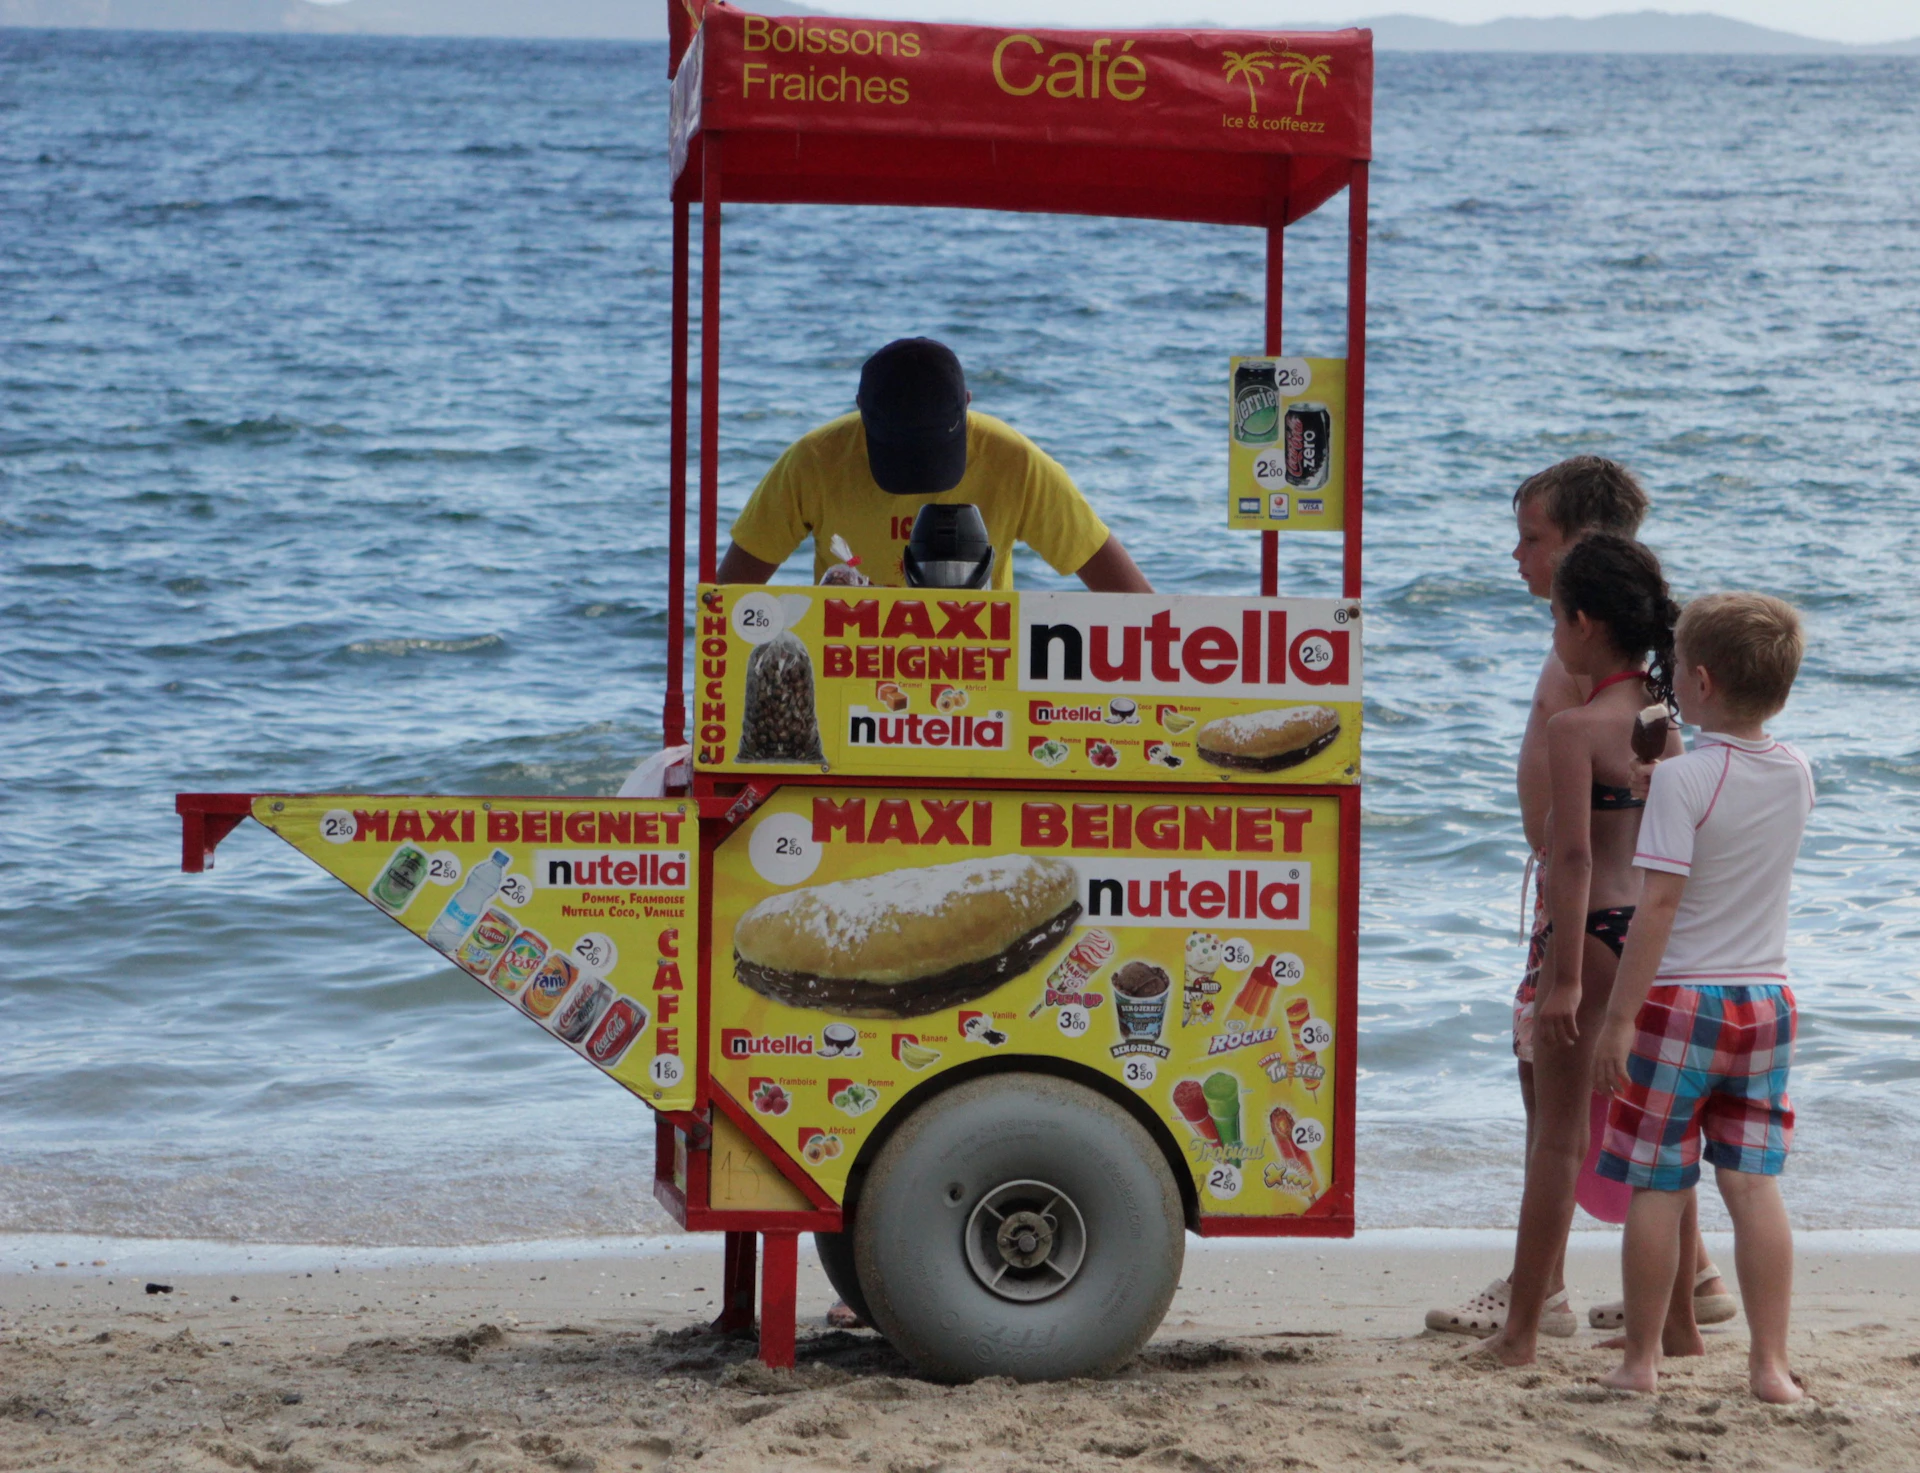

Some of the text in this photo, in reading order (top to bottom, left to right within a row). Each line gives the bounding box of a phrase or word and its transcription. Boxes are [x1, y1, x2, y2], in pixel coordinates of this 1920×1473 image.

[743, 16, 921, 58] Boissons
[992, 34, 1147, 101] Café
[742, 63, 910, 105] Fraiches
[1222, 114, 1326, 134] Ice & coffeezz
[1303, 430, 1316, 468] zero
[1303, 503, 1320, 511] VISA
[823, 598, 1011, 640] MAXI
[823, 644, 1011, 681] BEIGNET
[1109, 738, 1140, 746] Framboise
[353, 809, 686, 844] MAXI BEIGNET
[812, 797, 1313, 853] MAXI BEIGNET
[479, 925, 506, 943] Lipton
[501, 948, 542, 971] Oasis
[532, 968, 567, 990] Fanta
[992, 1011, 1017, 1020] Vanille
[858, 1031, 877, 1039] Coco
[921, 1034, 948, 1043] Banane
[1208, 1027, 1279, 1055] ROCKET
[1258, 1052, 1283, 1067] SUPER
[779, 1077, 818, 1086] Framboise
[867, 1078, 895, 1087] Pomme
[828, 1126, 856, 1135] Abricot
